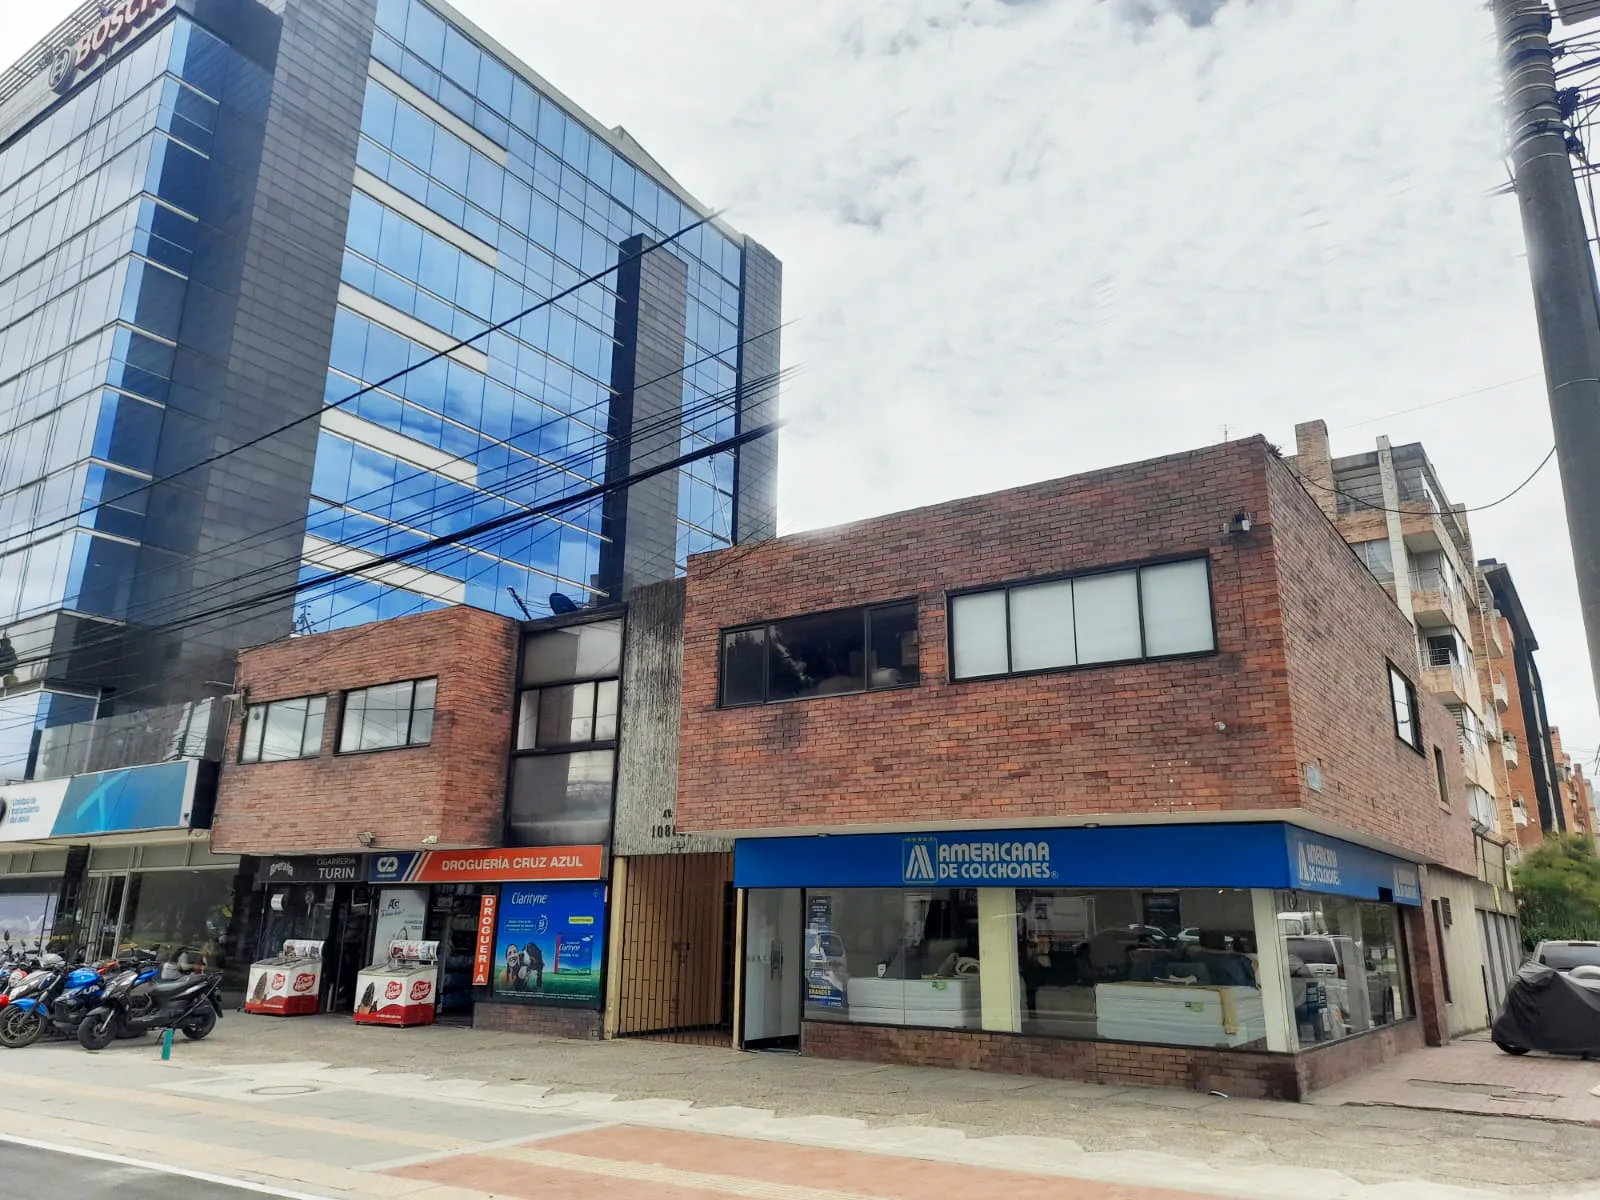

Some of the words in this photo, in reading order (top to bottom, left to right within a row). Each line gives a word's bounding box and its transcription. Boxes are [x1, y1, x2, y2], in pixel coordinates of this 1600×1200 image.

[939, 842, 1050, 862] AMERICANA
[441, 855, 510, 871] DROGUERÍA
[512, 856, 547, 869] CRUZ
[550, 856, 583, 868] AZUL
[939, 863, 958, 879] DE
[960, 862, 1051, 879] COLCHONES
[317, 867, 356, 880] TURIN
[511, 892, 548, 906] Clarityne
[475, 897, 493, 983] DROGUERIA
